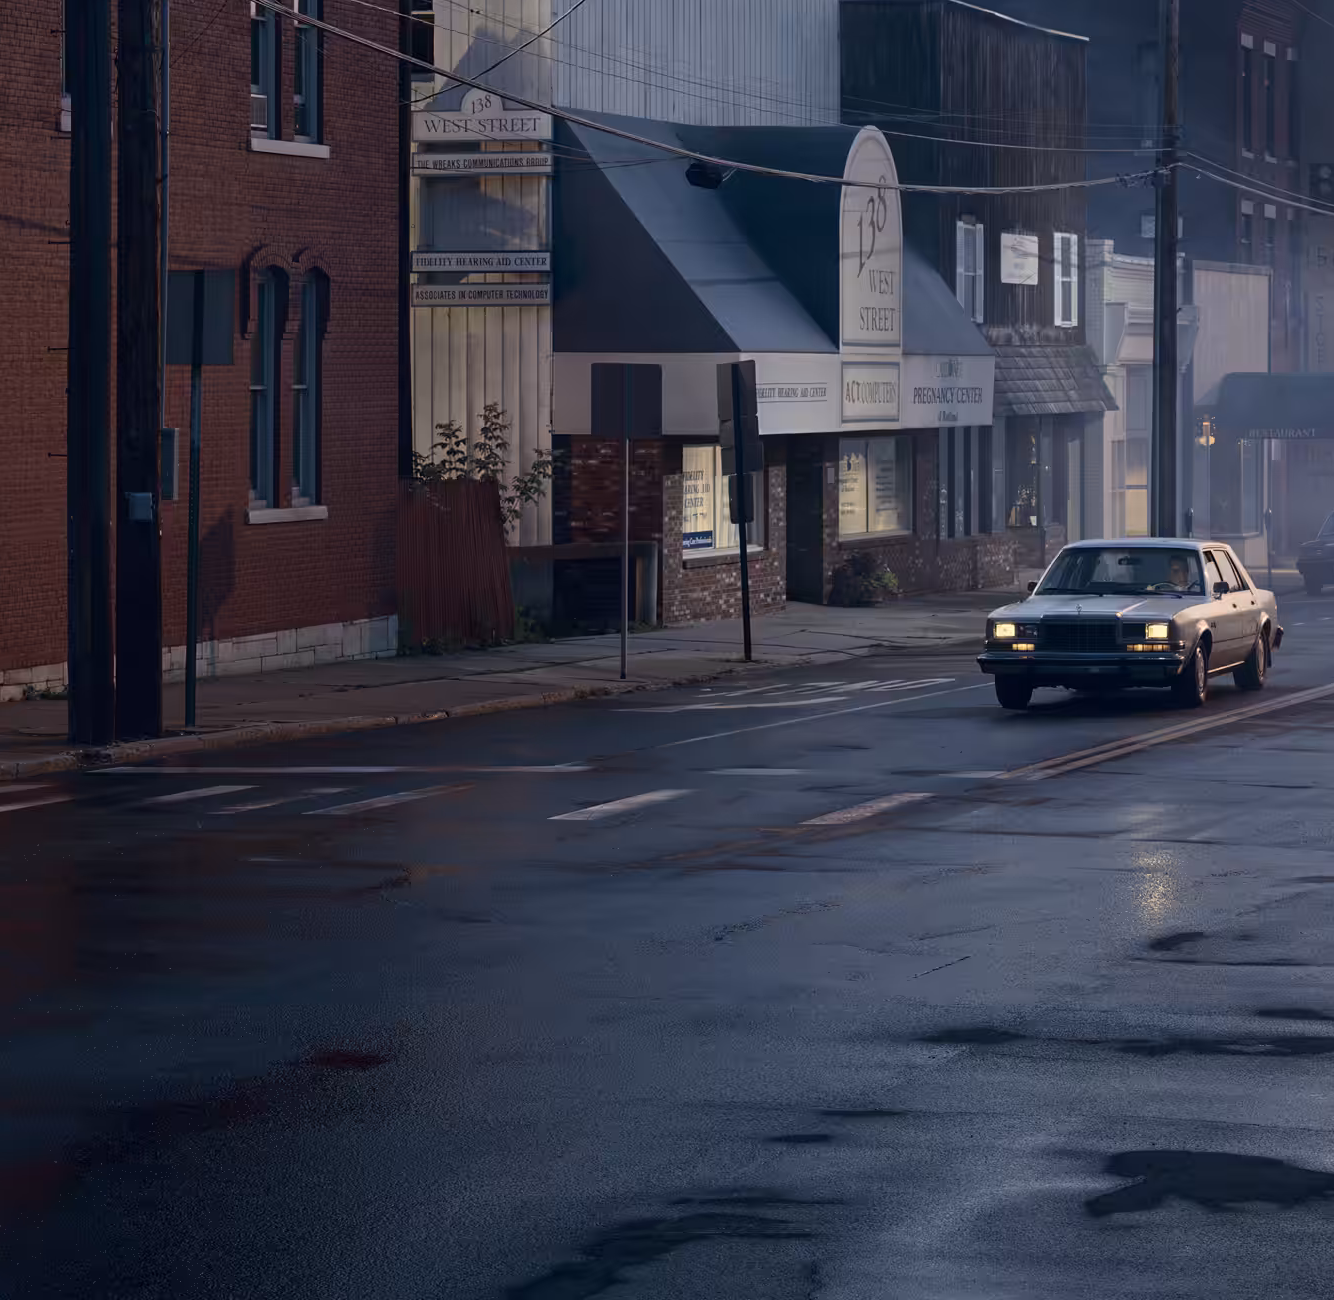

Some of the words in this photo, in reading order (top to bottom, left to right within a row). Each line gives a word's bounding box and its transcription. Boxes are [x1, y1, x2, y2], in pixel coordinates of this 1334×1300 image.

[471, 93, 492, 115] 138
[424, 118, 472, 133] WEST
[478, 117, 541, 133] STREET
[418, 160, 429, 169] THE
[432, 159, 461, 170] WREAKS
[463, 158, 524, 168] COMMUNICATIONS
[856, 175, 887, 278] 138
[416, 257, 453, 267] FIDELITY
[456, 257, 493, 267] HEARING
[496, 257, 511, 266] AID
[514, 256, 547, 266] CENTER
[869, 269, 894, 296] WEST
[415, 290, 456, 301] ASSOCIATES
[458, 290, 466, 300] IN
[468, 290, 504, 300] COMPUTER
[506, 289, 549, 300] TECHNOLOGY
[859, 306, 896, 333] STREET
[913, 387, 955, 405] PREGNANCY
[956, 387, 983, 404] CENTER
